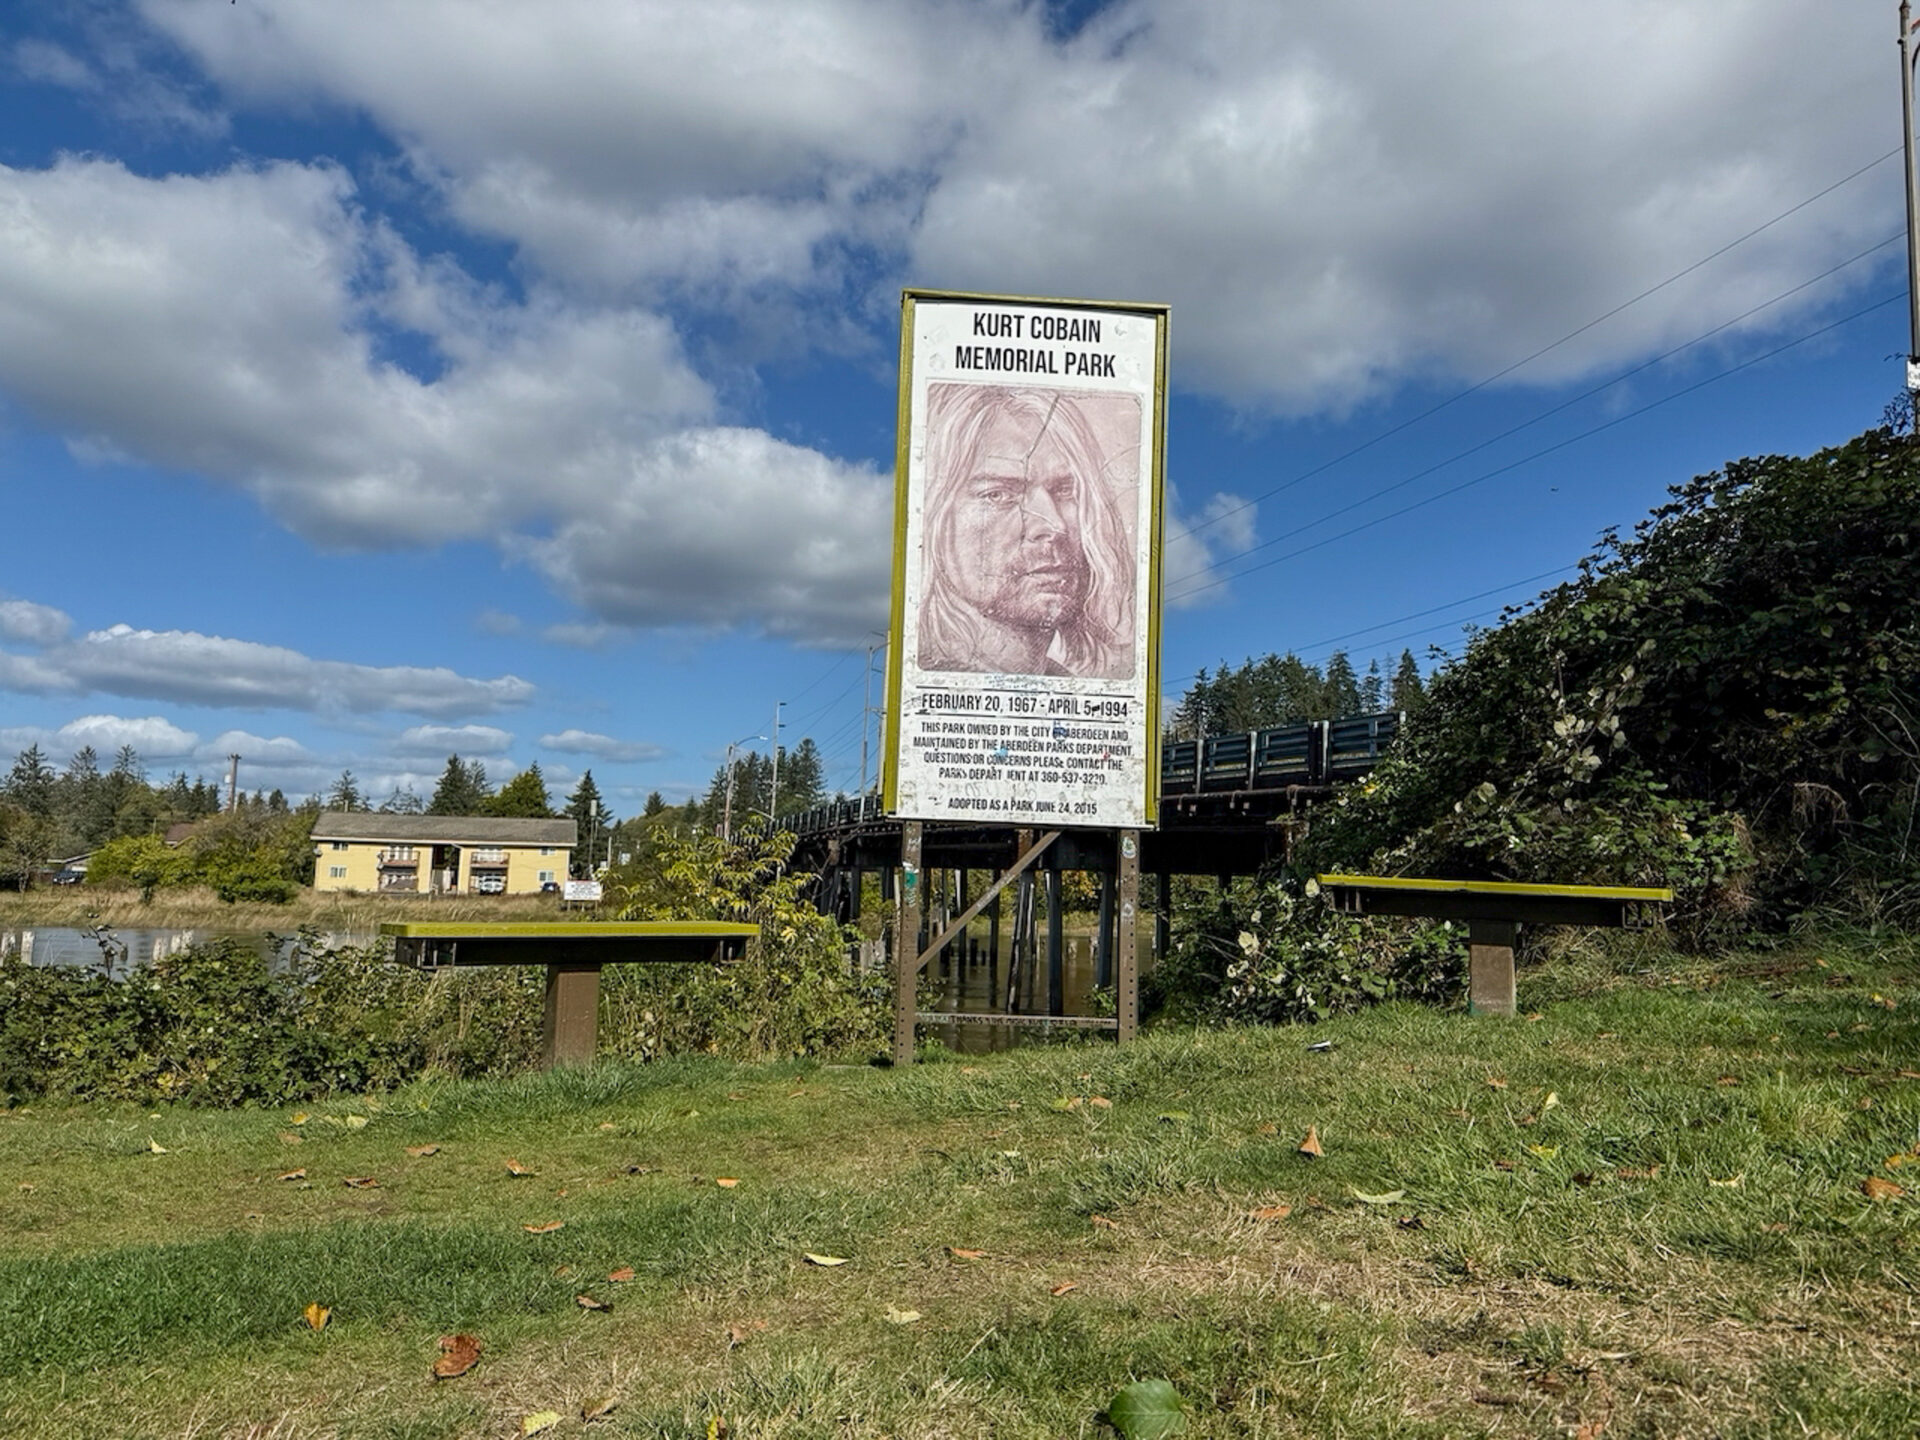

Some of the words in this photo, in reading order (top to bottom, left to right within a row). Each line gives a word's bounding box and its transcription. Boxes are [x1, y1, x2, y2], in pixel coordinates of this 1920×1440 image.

[973, 312, 1025, 338] KURT
[1030, 315, 1101, 343] COBAIN
[955, 346, 1058, 374] MEMORIAL
[1064, 352, 1116, 378] PARK
[921, 693, 983, 711] FEBRUARY
[985, 696, 1004, 713] 20,
[1008, 697, 1037, 713] 1967
[1048, 699, 1081, 715] APRIL
[1099, 701, 1128, 717] 1994
[921, 721, 941, 733] THIS
[942, 722, 965, 734] PARK
[967, 723, 998, 736] OWNED
[1000, 725, 1012, 736] BY
[1014, 726, 1029, 737] THE
[1031, 726, 1051, 738] CITY
[1065, 727, 1109, 740] ABERDEEN
[1111, 730, 1129, 742] AND
[913, 736, 967, 749] MAINTAINED
[968, 738, 980, 750] BY
[982, 739, 998, 751] THE
[1000, 740, 1044, 752] ABERDEEN
[1046, 742, 1075, 754] PARKS
[1076, 743, 1135, 757] DEPARTMENT.
[923, 751, 971, 764] QUESTIONS
[973, 753, 985, 765] OR
[986, 755, 1031, 767] CONCERNS
[1066, 757, 1105, 770] CONTACT
[1107, 759, 1123, 771] THE
[1028, 771, 1039, 781] AT
[948, 797, 988, 810] ADOPTED
[989, 799, 1001, 811] AS
[1002, 800, 1009, 811] A
[1010, 799, 1034, 812] PARK
[1035, 801, 1056, 813] JUNE
[1074, 802, 1098, 815] 2015
